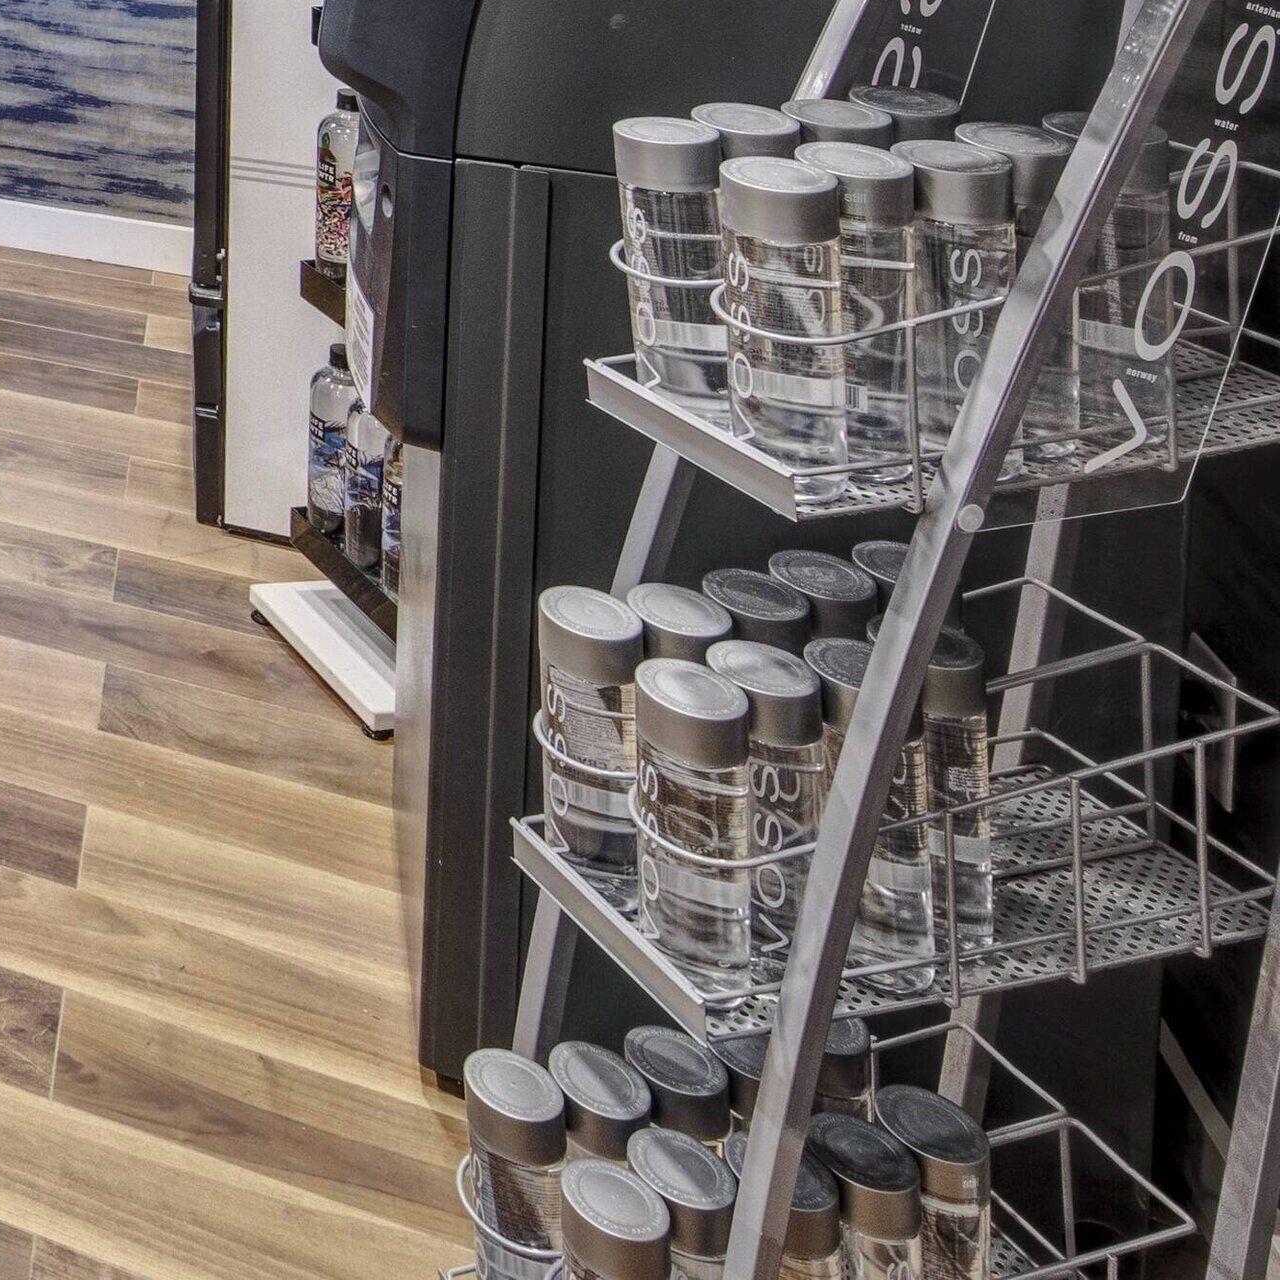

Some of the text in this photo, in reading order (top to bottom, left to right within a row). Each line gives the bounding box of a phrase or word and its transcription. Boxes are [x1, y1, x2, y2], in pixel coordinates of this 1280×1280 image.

[1245, 1, 1280, 19] artesian
[1213, 116, 1240, 132] water
[844, 192, 867, 203] still
[1083, 21, 1276, 474] VOSS
[1177, 230, 1198, 247] from
[950, 248, 984, 412] OSS
[1125, 365, 1159, 384] norway
[750, 763, 790, 953] VOSS
